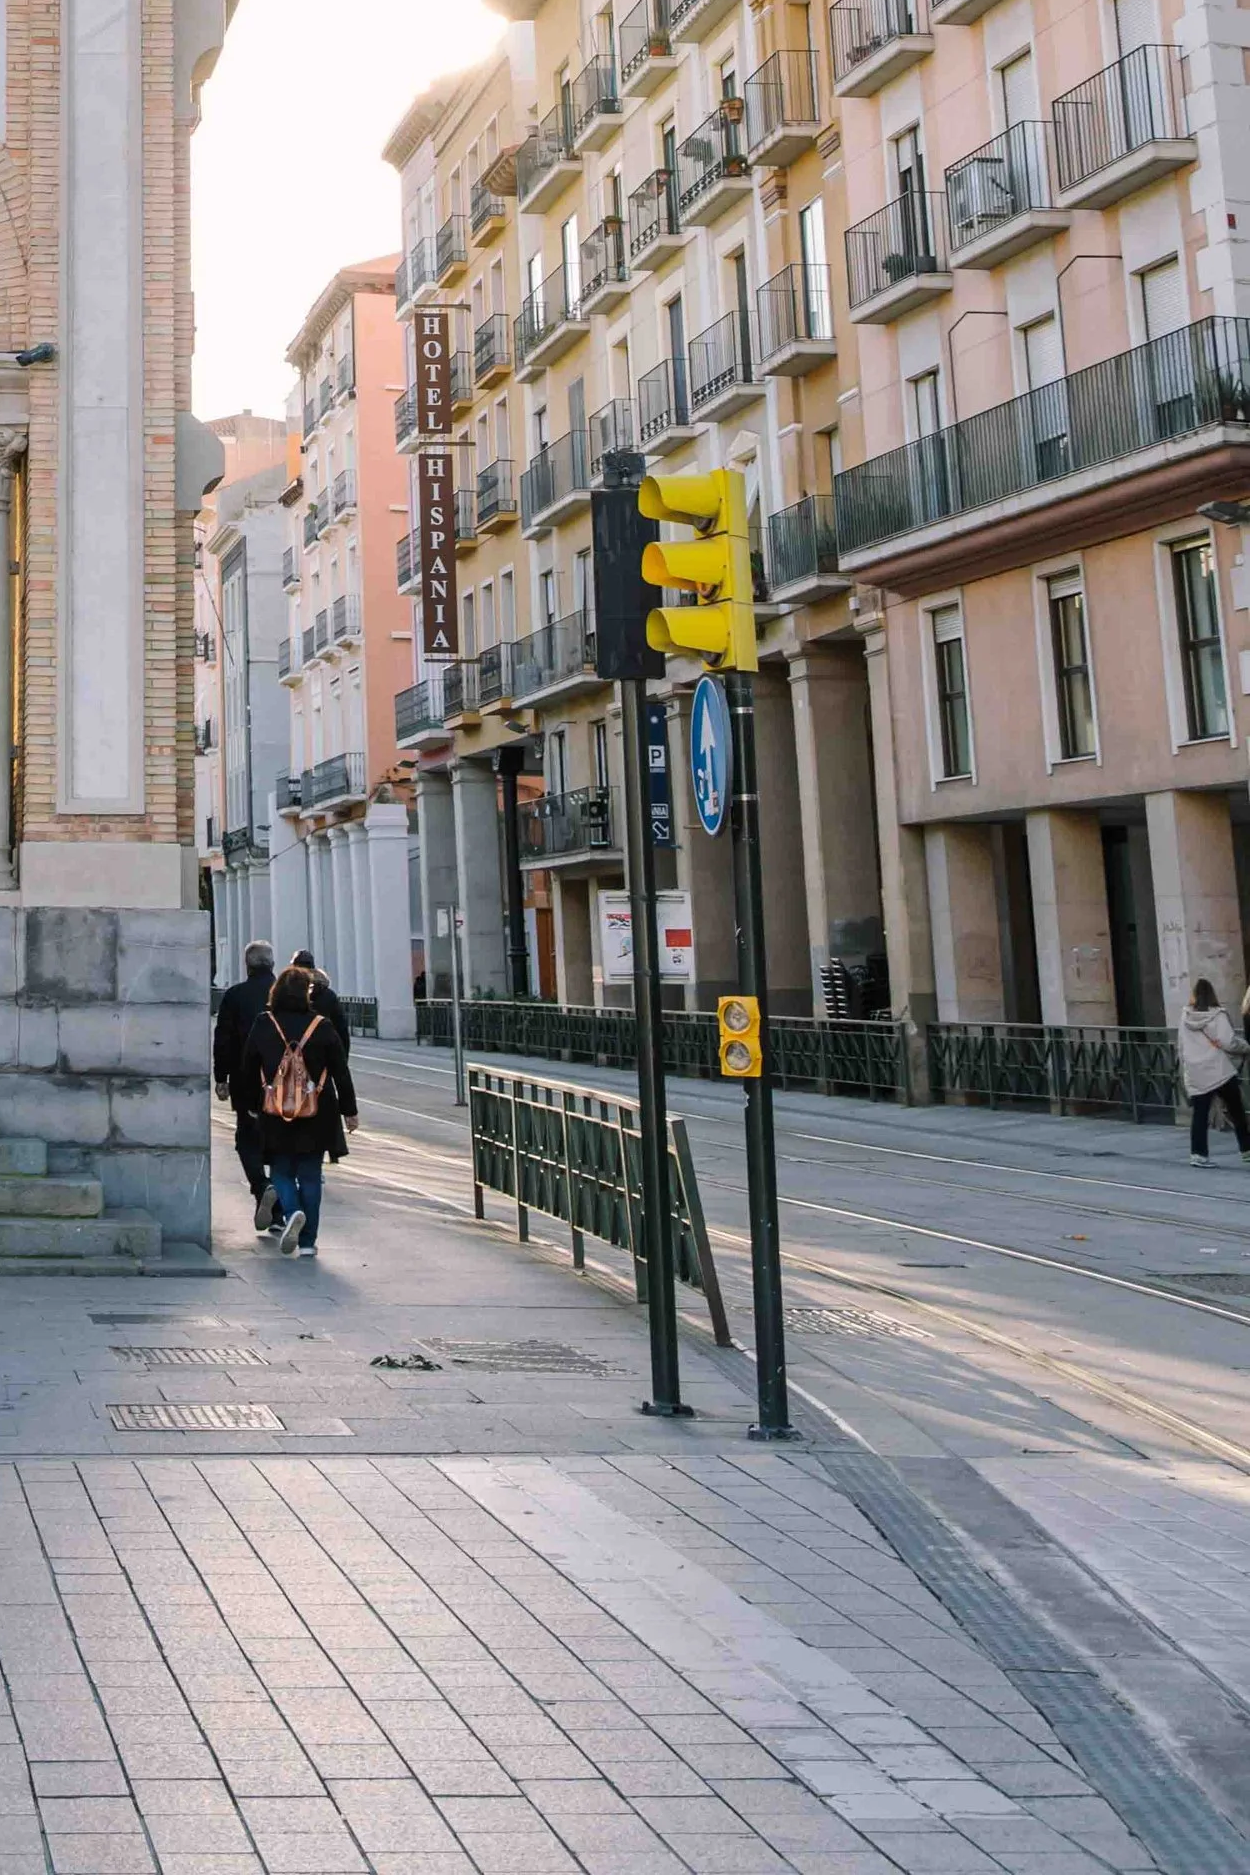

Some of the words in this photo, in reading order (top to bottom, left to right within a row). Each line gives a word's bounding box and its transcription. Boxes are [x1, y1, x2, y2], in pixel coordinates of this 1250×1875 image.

[422, 317, 443, 430] HOTEL
[425, 458, 450, 648] HISPANIA
[651, 748, 662, 765] P
